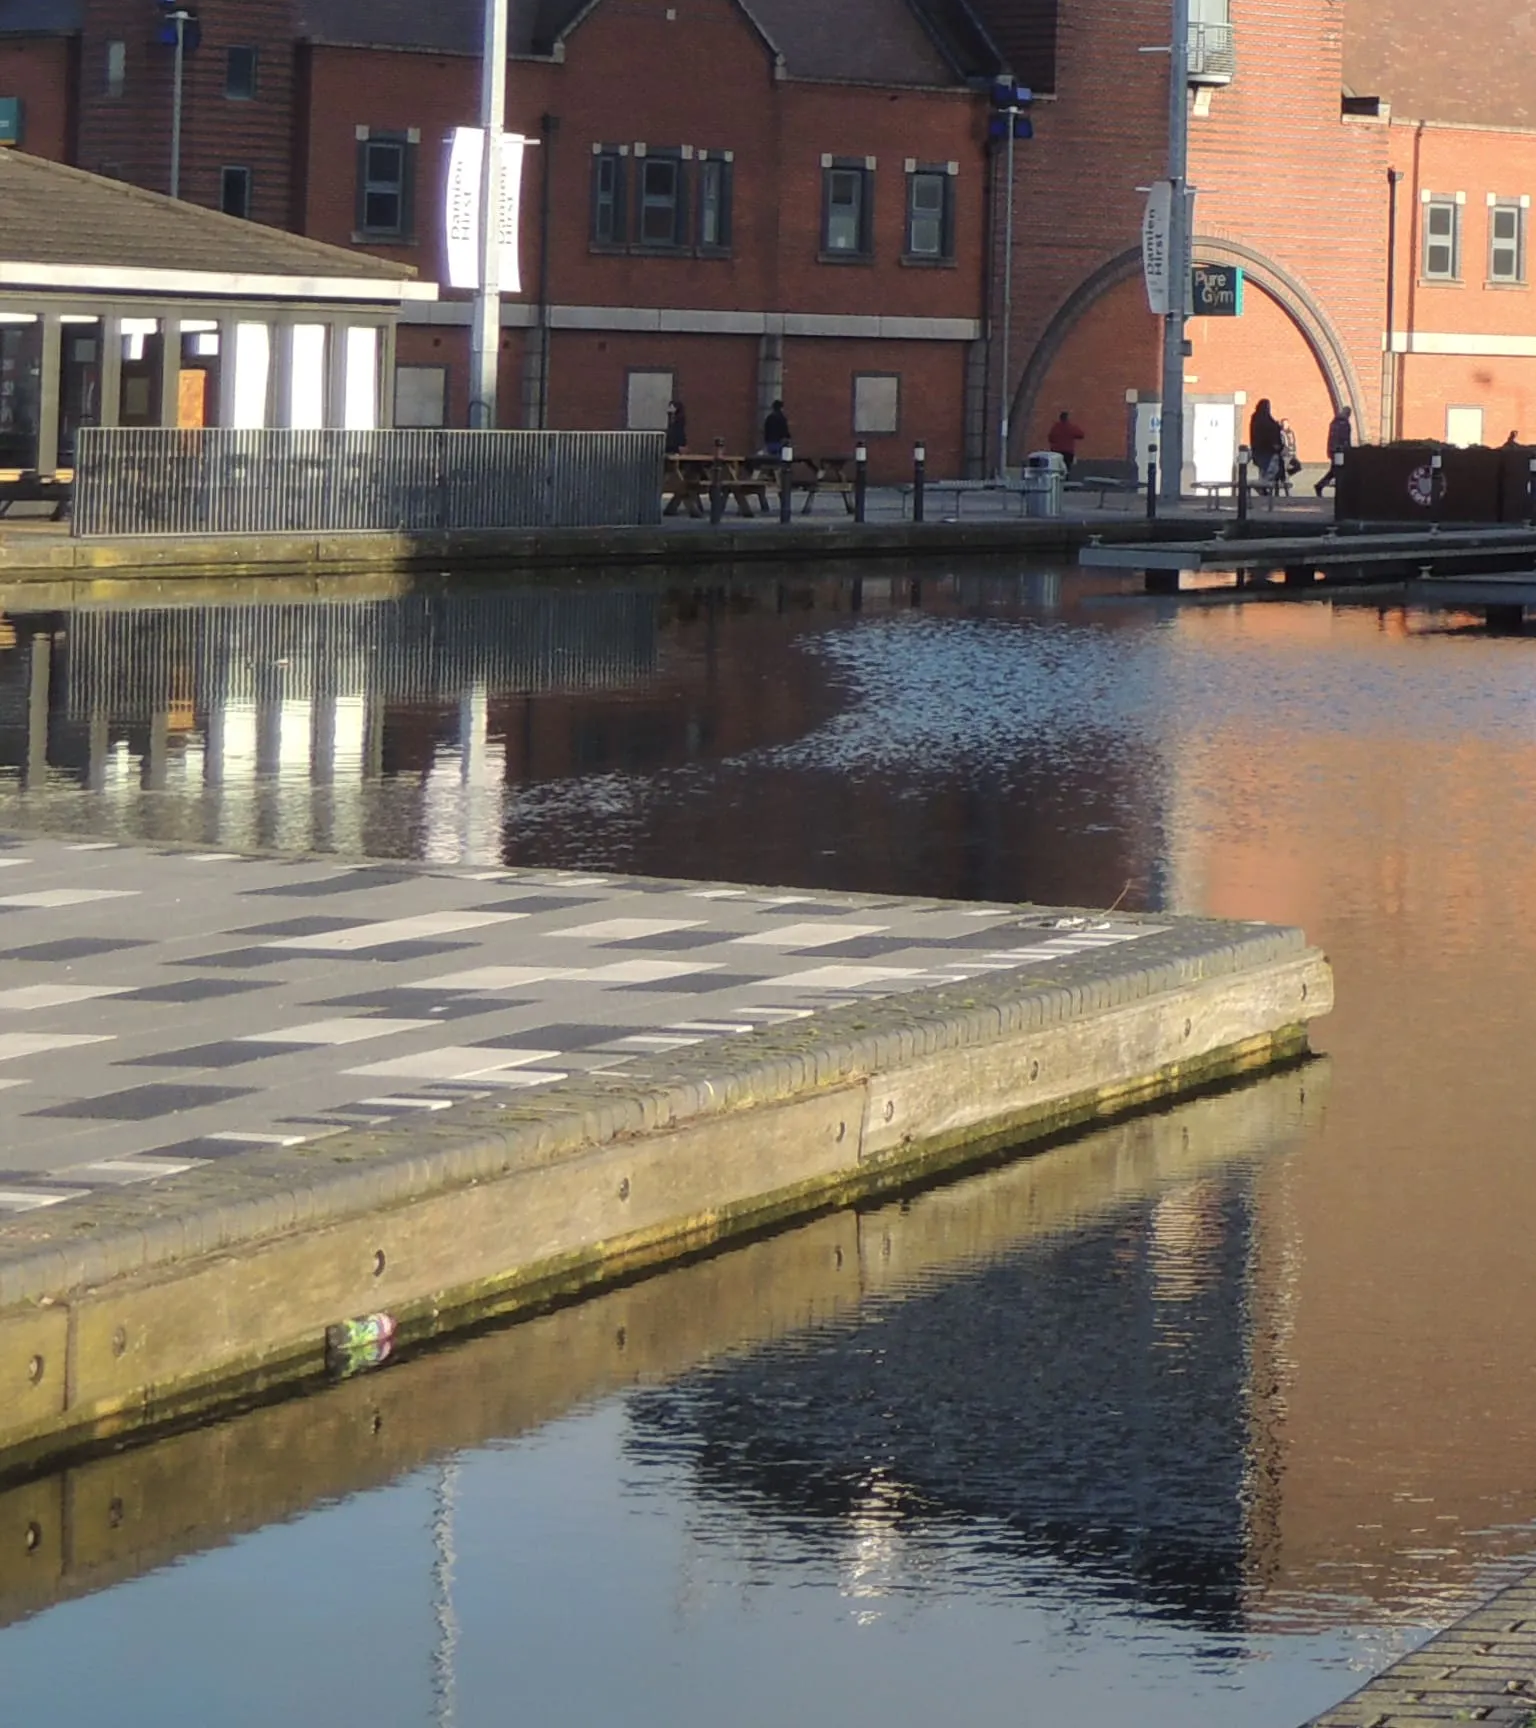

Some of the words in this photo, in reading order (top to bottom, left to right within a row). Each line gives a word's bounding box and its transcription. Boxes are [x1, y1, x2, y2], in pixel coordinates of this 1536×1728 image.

[450, 160, 463, 241] Damien
[461, 192, 472, 241] Hirst
[1145, 208, 1156, 276] Damien
[1154, 233, 1164, 276] Hirst
[1194, 270, 1227, 287] Pure
[1201, 286, 1234, 307] Gym
